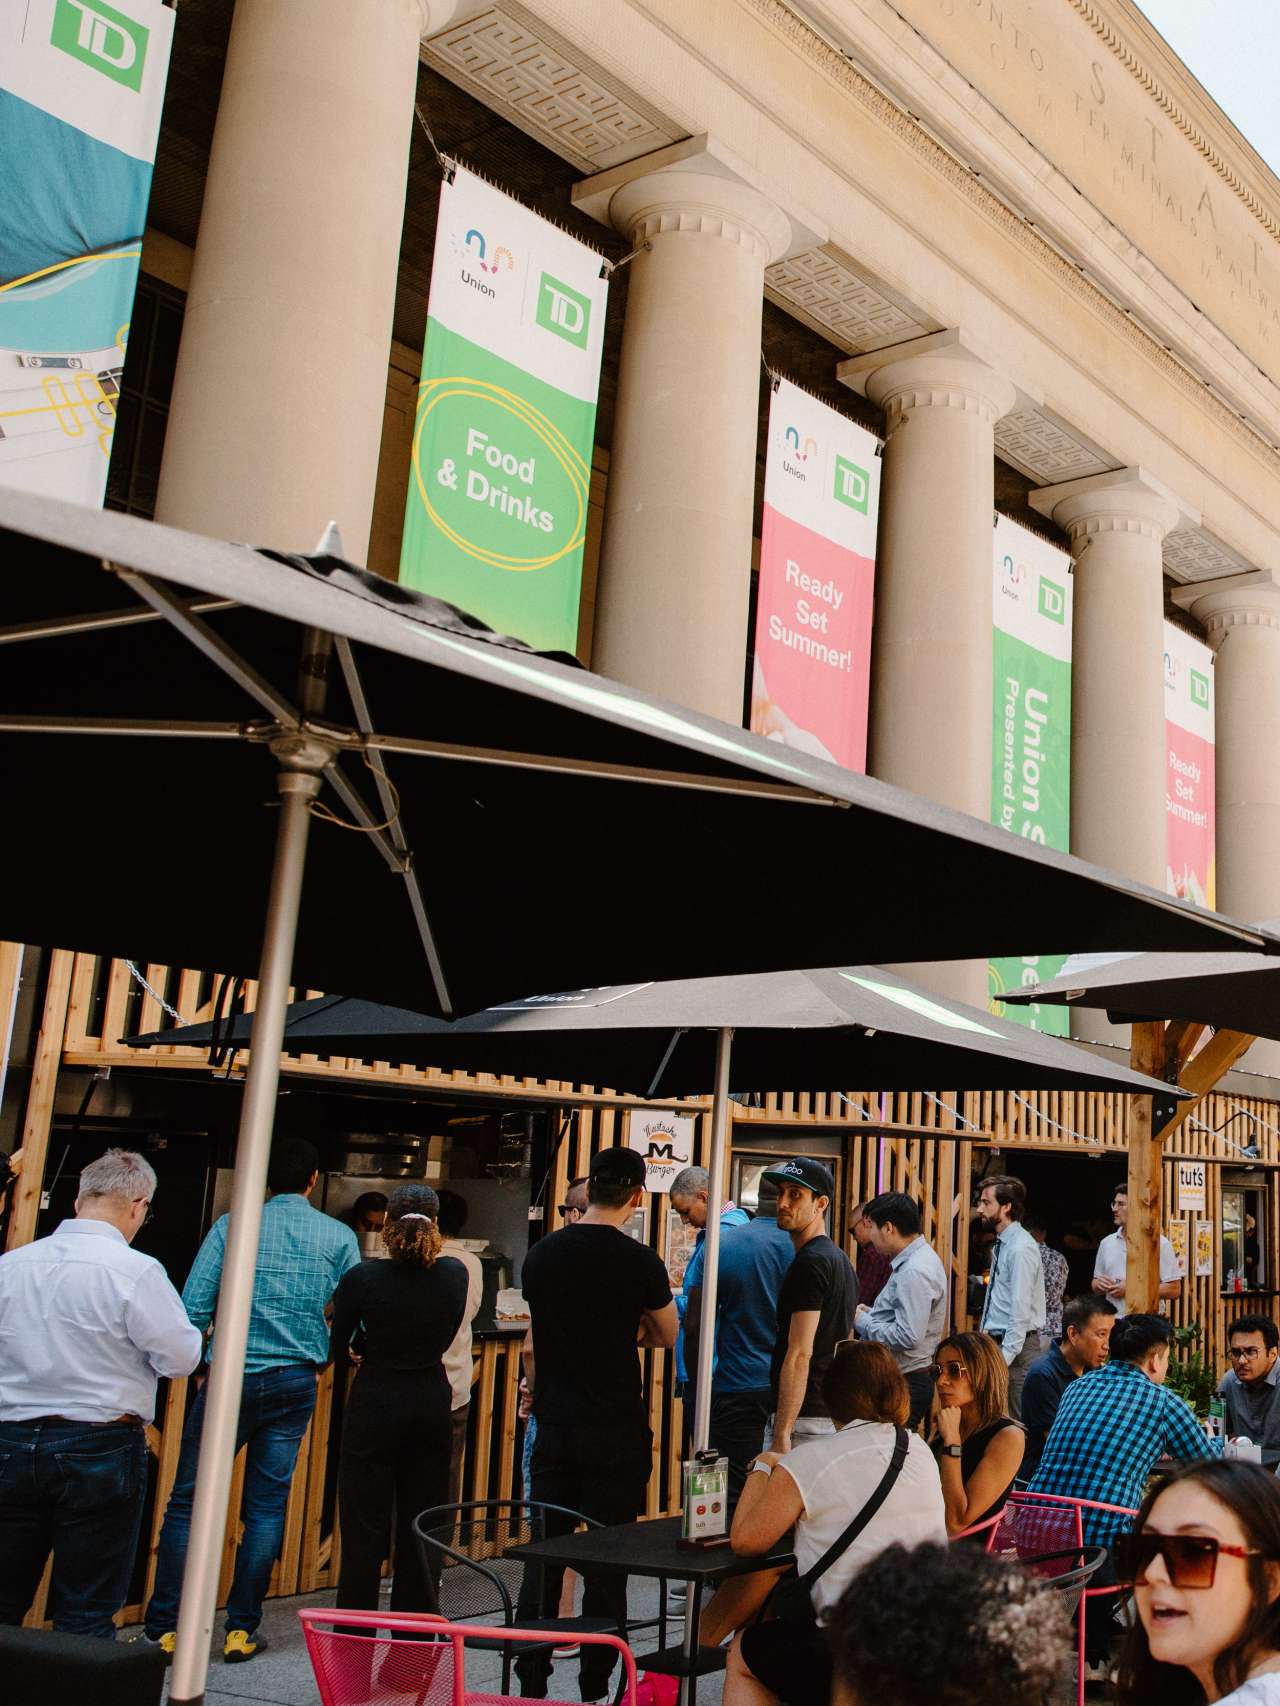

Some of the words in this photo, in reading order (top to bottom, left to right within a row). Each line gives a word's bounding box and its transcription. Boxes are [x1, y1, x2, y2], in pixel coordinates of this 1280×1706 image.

[66, 0, 136, 69] TD
[460, 269, 496, 299] Union
[544, 284, 584, 335] TD
[466, 428, 536, 485] Food
[783, 460, 807, 482] Union
[437, 458, 457, 490] &
[466, 470, 554, 533] Drinks
[839, 464, 866, 503] TD
[786, 559, 843, 610] Ready
[1041, 583, 1063, 614] TD
[796, 599, 829, 634] Set
[769, 616, 852, 672] Summer!
[1191, 675, 1208, 702] TD
[1003, 676, 1020, 800] Presented
[1022, 687, 1049, 813] Union
[1169, 751, 1201, 783] Ready
[1175, 779, 1194, 802] Set
[1000, 804, 1015, 832] by
[1166, 794, 1208, 829] Summer!
[649, 1142, 673, 1160] M
[646, 1163, 677, 1179] Burger
[1180, 1167, 1203, 1187] tut's
